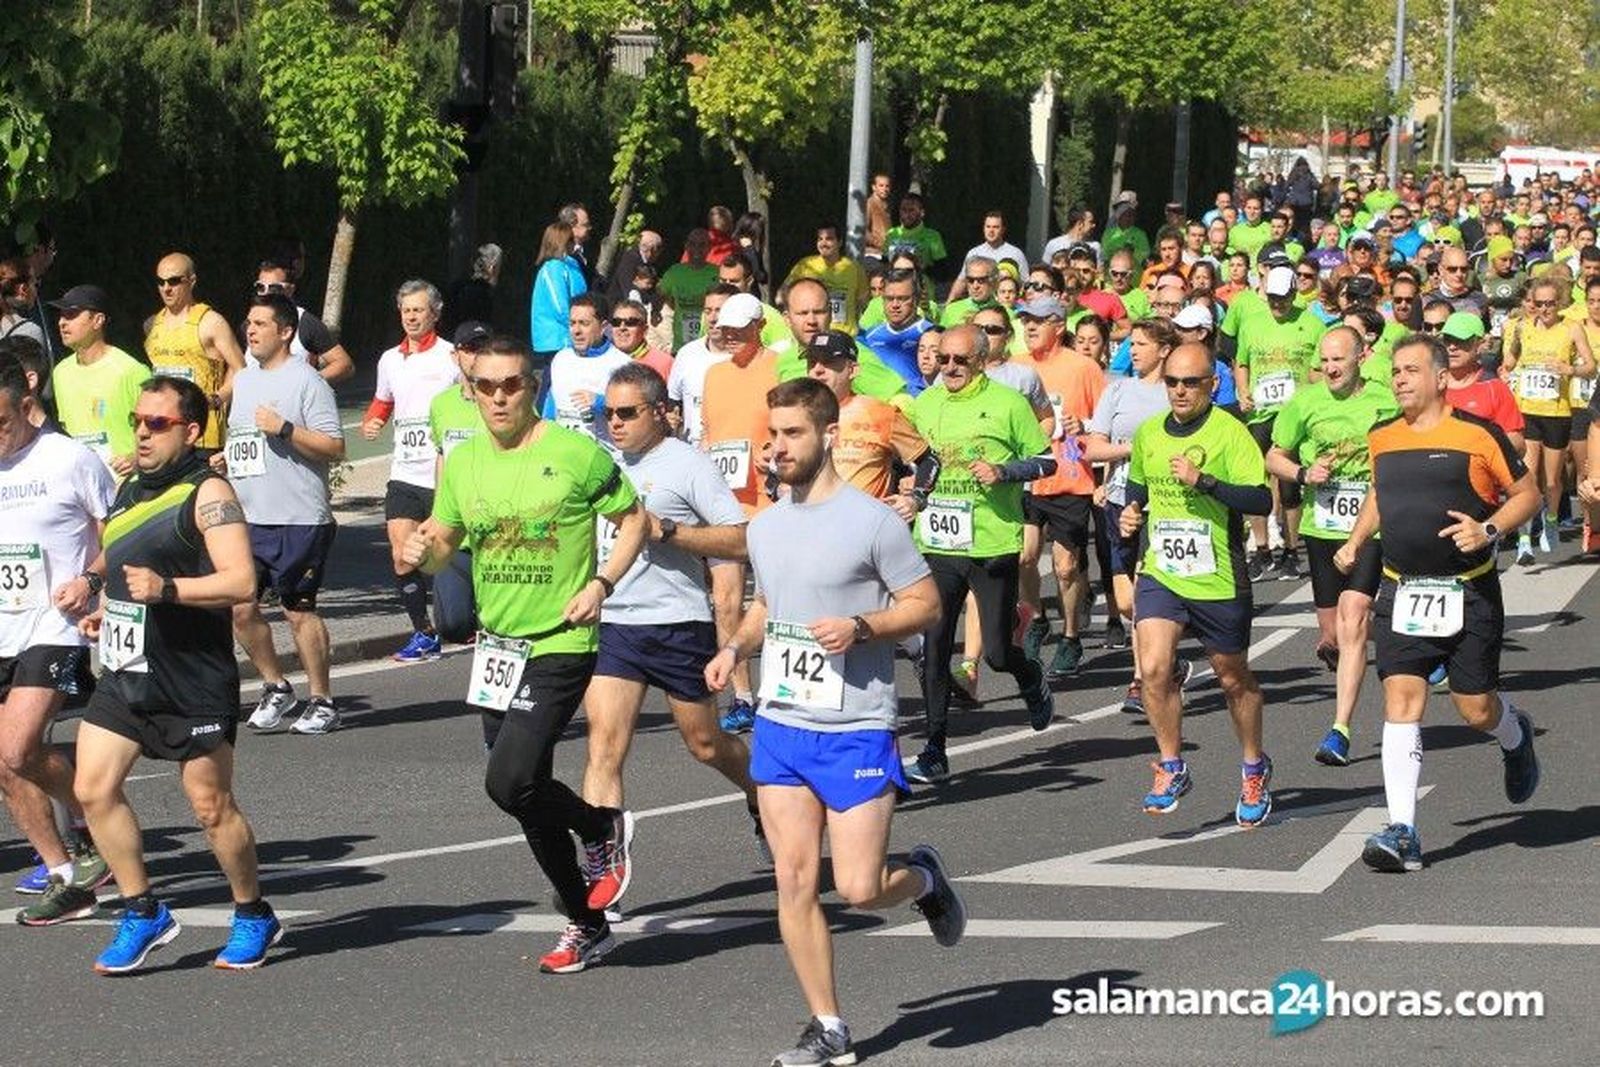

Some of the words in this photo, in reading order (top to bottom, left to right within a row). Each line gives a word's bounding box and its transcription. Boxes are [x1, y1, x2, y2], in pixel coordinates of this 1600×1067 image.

[1264, 383, 1286, 400] 137
[1526, 375, 1556, 389] 1152
[229, 440, 258, 461] 1090
[714, 456, 739, 476] 00
[1329, 497, 1360, 517] 168
[929, 513, 960, 535] 640
[1162, 537, 1199, 560] 564
[1409, 594, 1446, 618] 771
[484, 657, 516, 689] 550
[781, 648, 825, 683] 142
